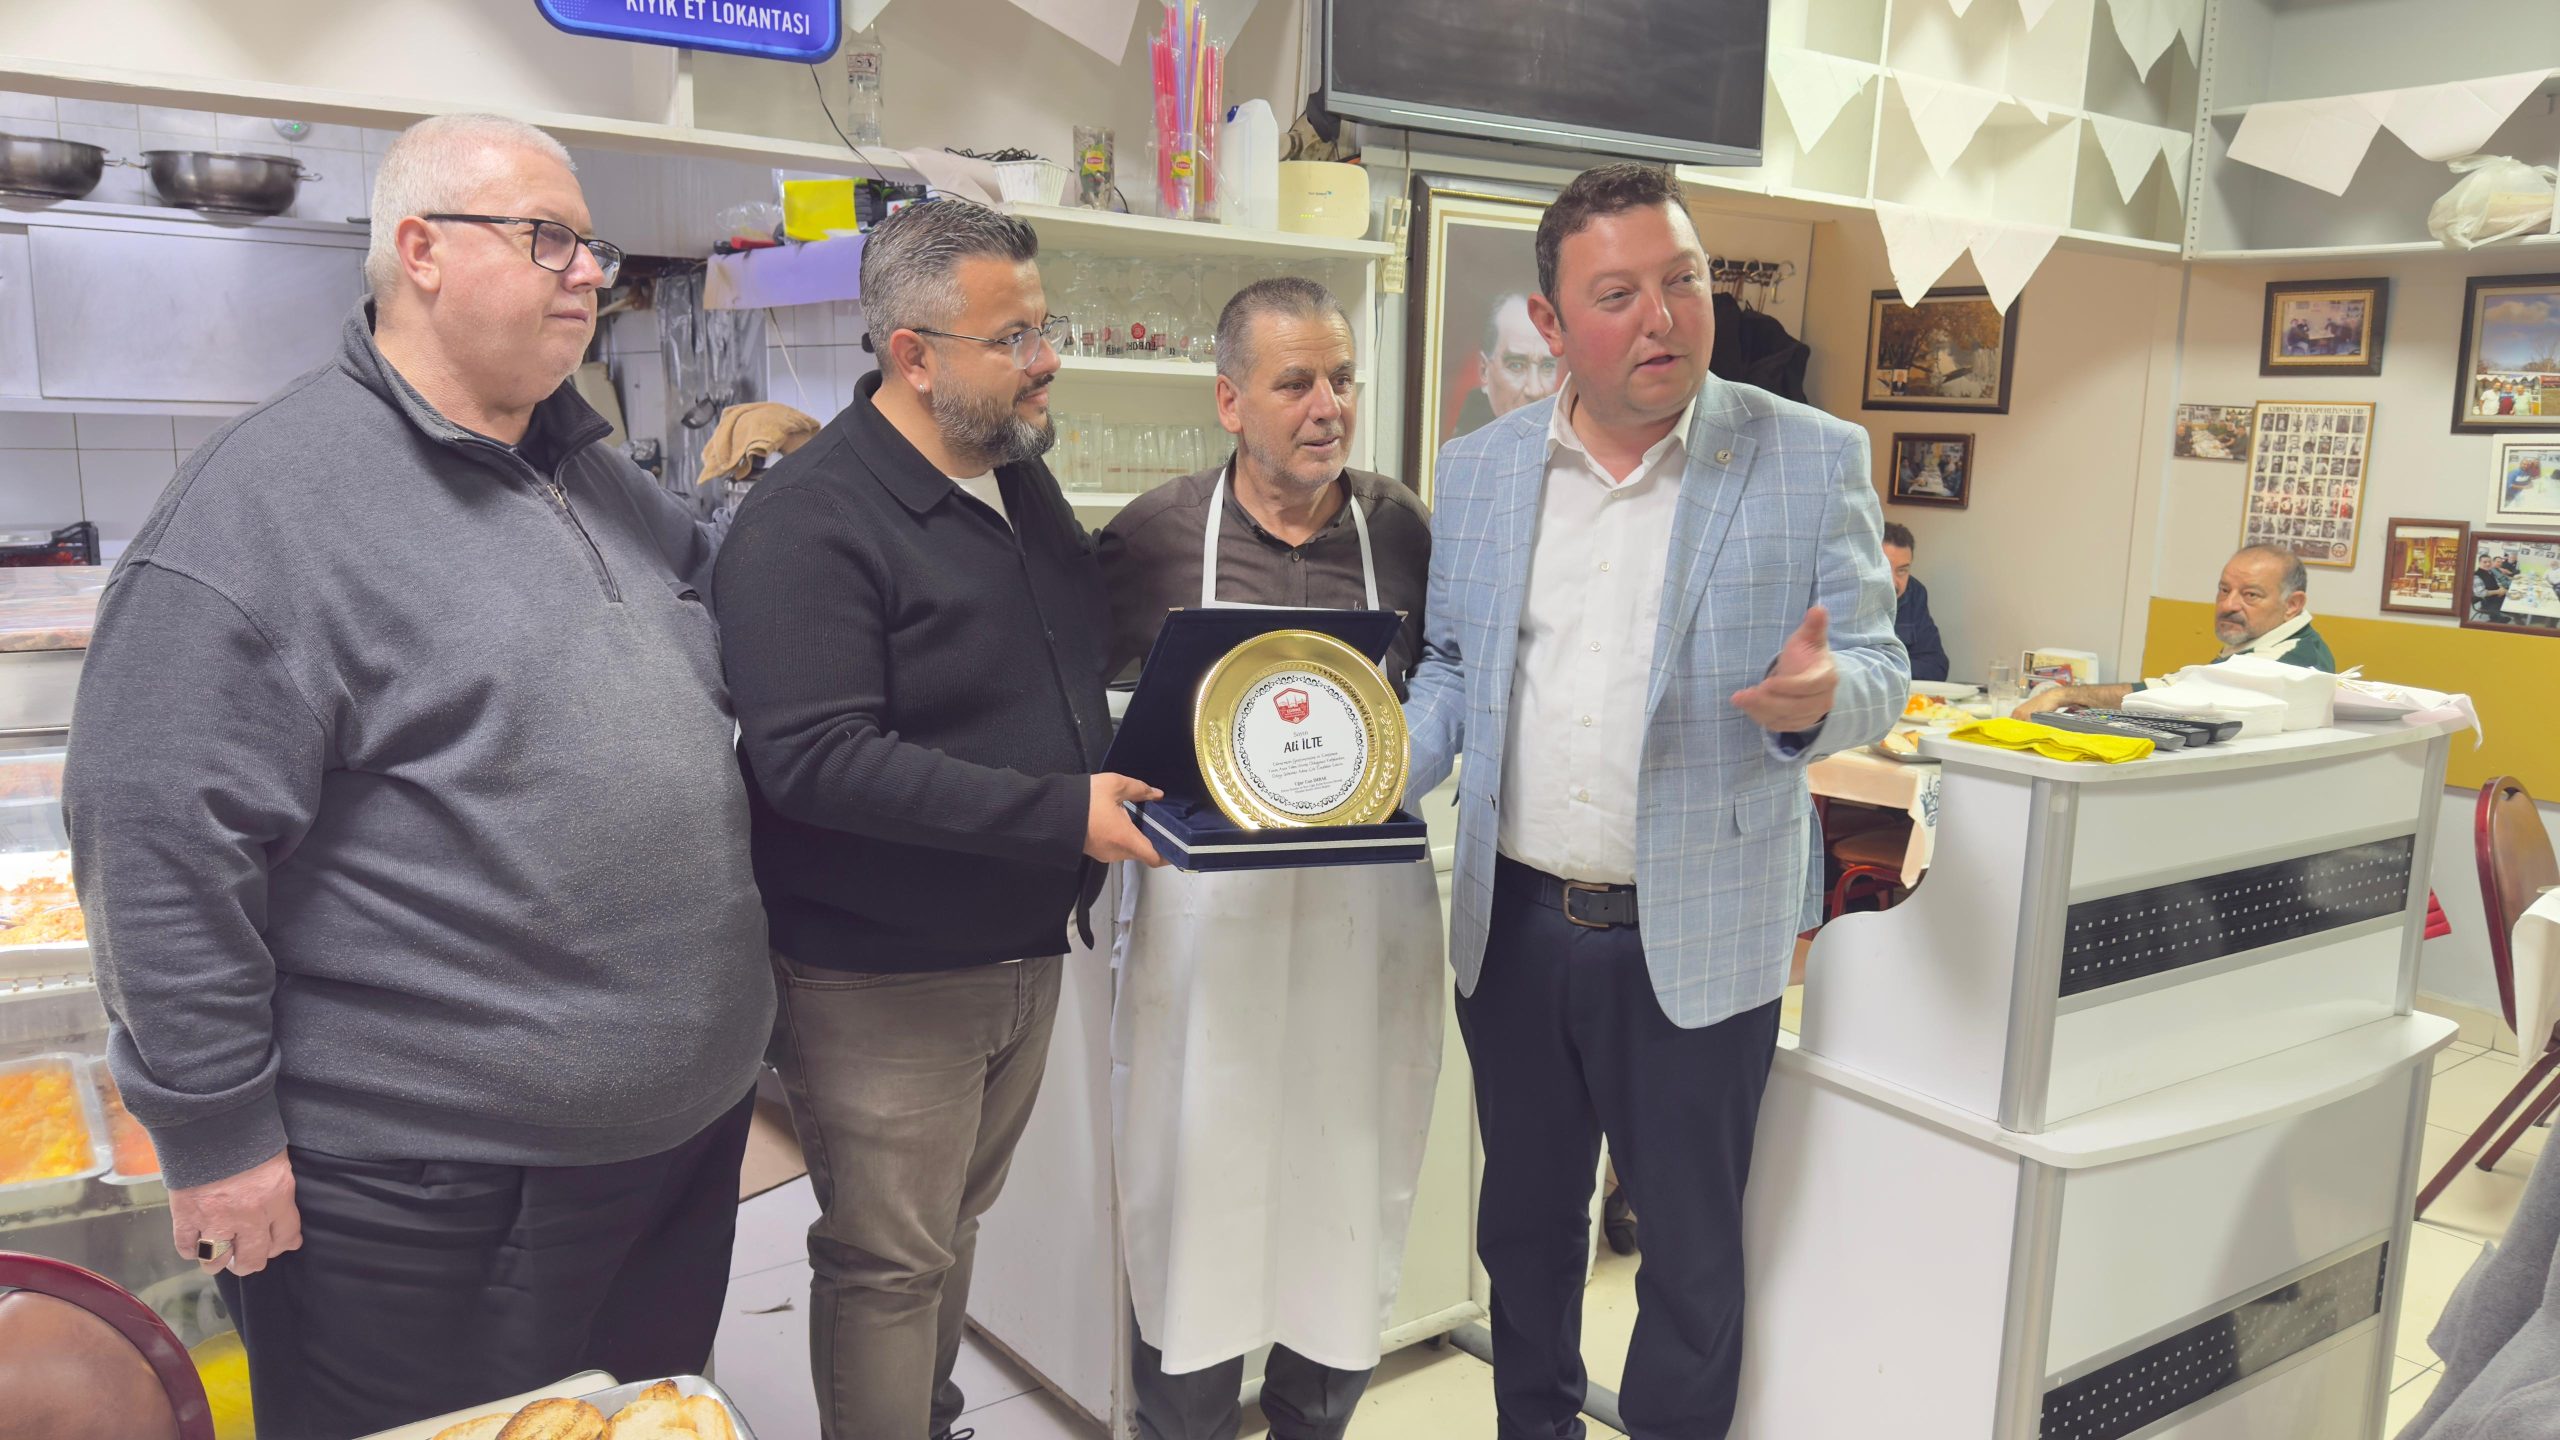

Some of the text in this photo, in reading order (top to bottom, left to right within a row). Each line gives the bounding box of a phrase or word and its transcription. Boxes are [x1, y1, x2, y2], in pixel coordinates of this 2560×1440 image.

[684, 0, 705, 20] ET
[713, 1, 810, 35] LOKANTASI
[1284, 740, 1299, 753] Ali
